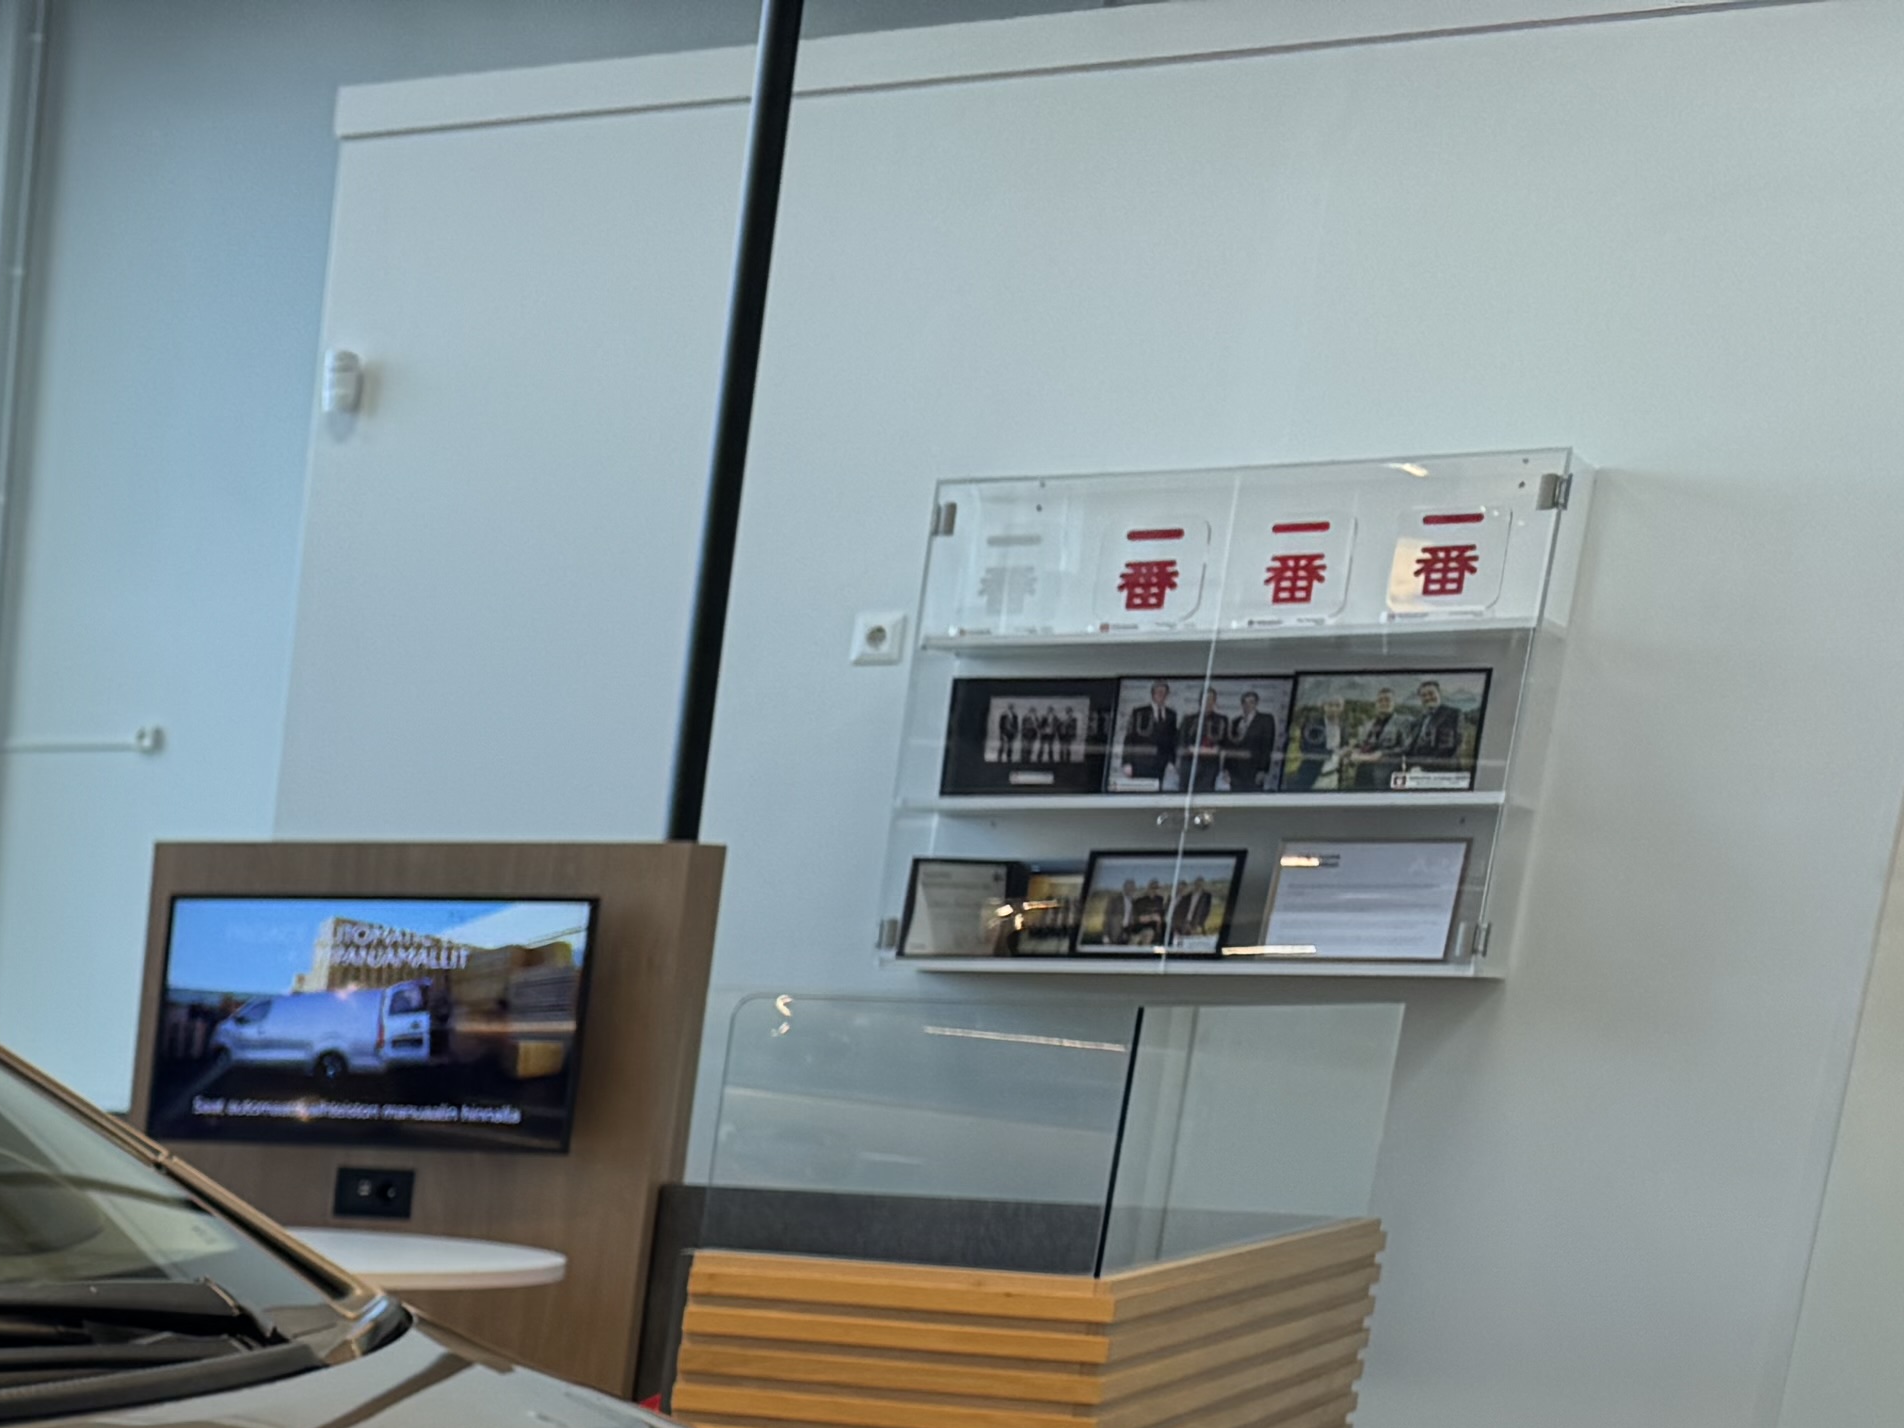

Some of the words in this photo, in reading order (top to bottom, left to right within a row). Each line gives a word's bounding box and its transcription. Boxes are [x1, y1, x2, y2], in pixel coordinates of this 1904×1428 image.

[1117, 528, 1185, 611] 一番
[1264, 521, 1331, 605] 一番
[1413, 513, 1485, 597] 一番
